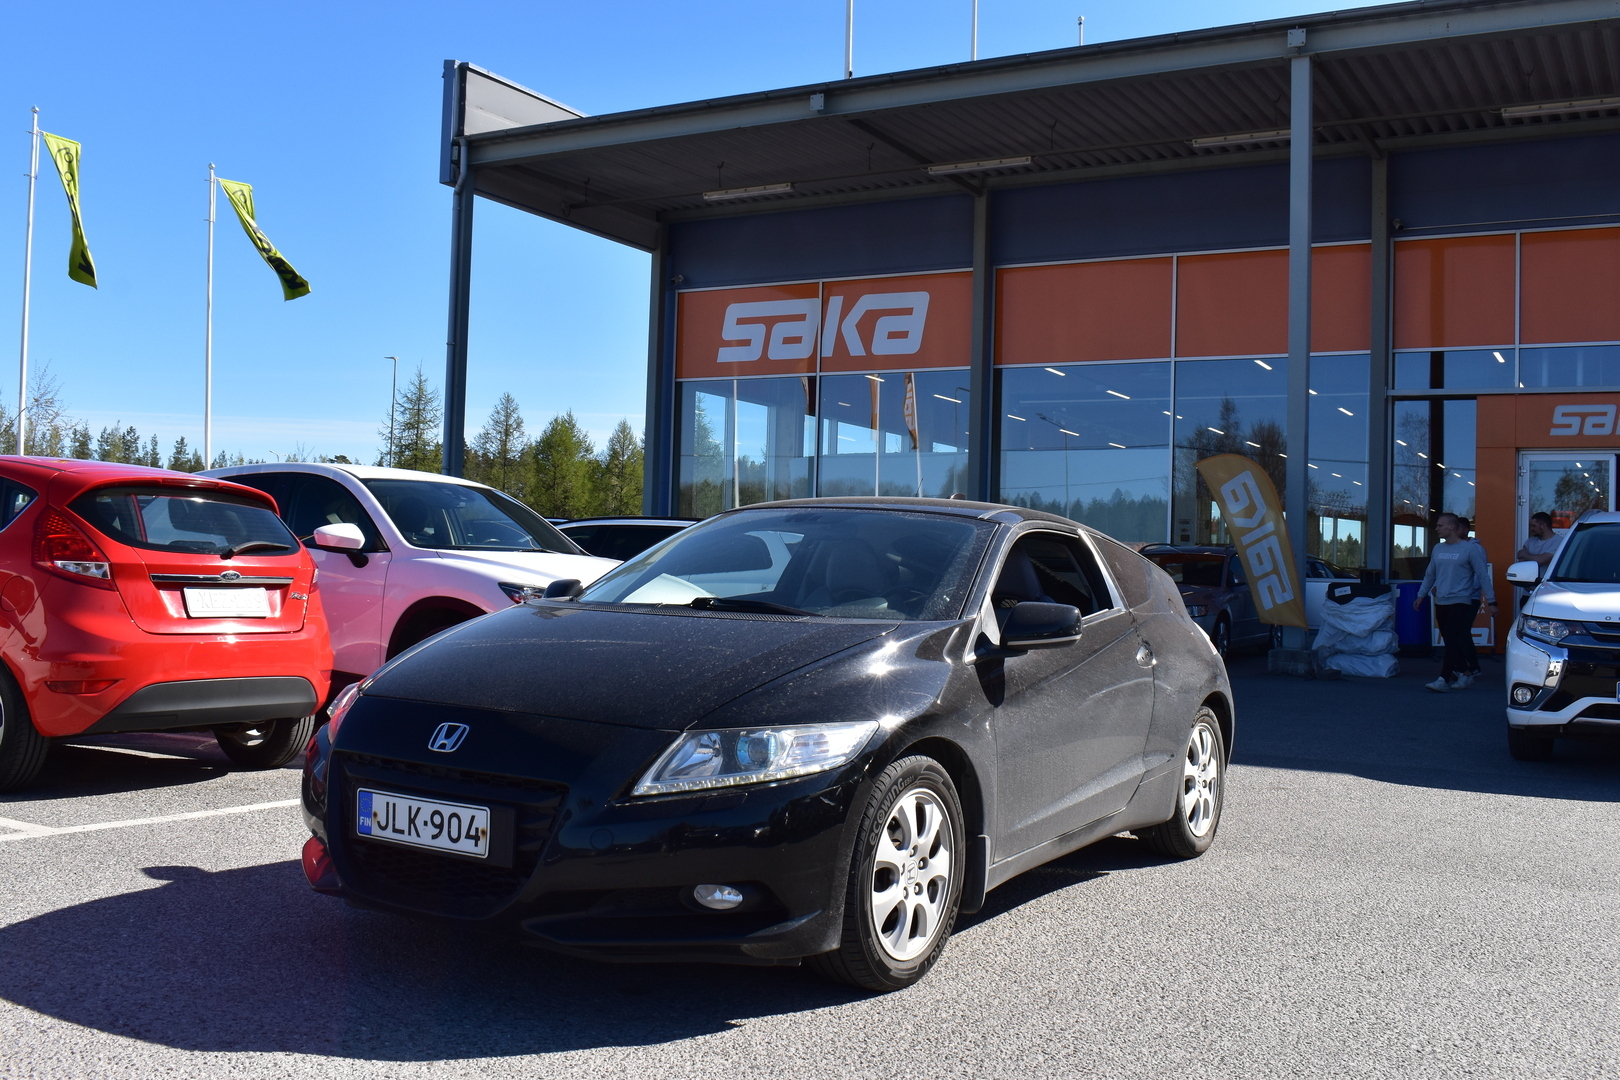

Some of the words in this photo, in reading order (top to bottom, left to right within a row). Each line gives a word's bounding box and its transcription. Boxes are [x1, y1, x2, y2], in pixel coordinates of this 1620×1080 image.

[1550, 404, 1620, 436] sa
[359, 816, 372, 828] FIN
[376, 801, 481, 848] JLK-904
[930, 905, 957, 964] KUMHO
